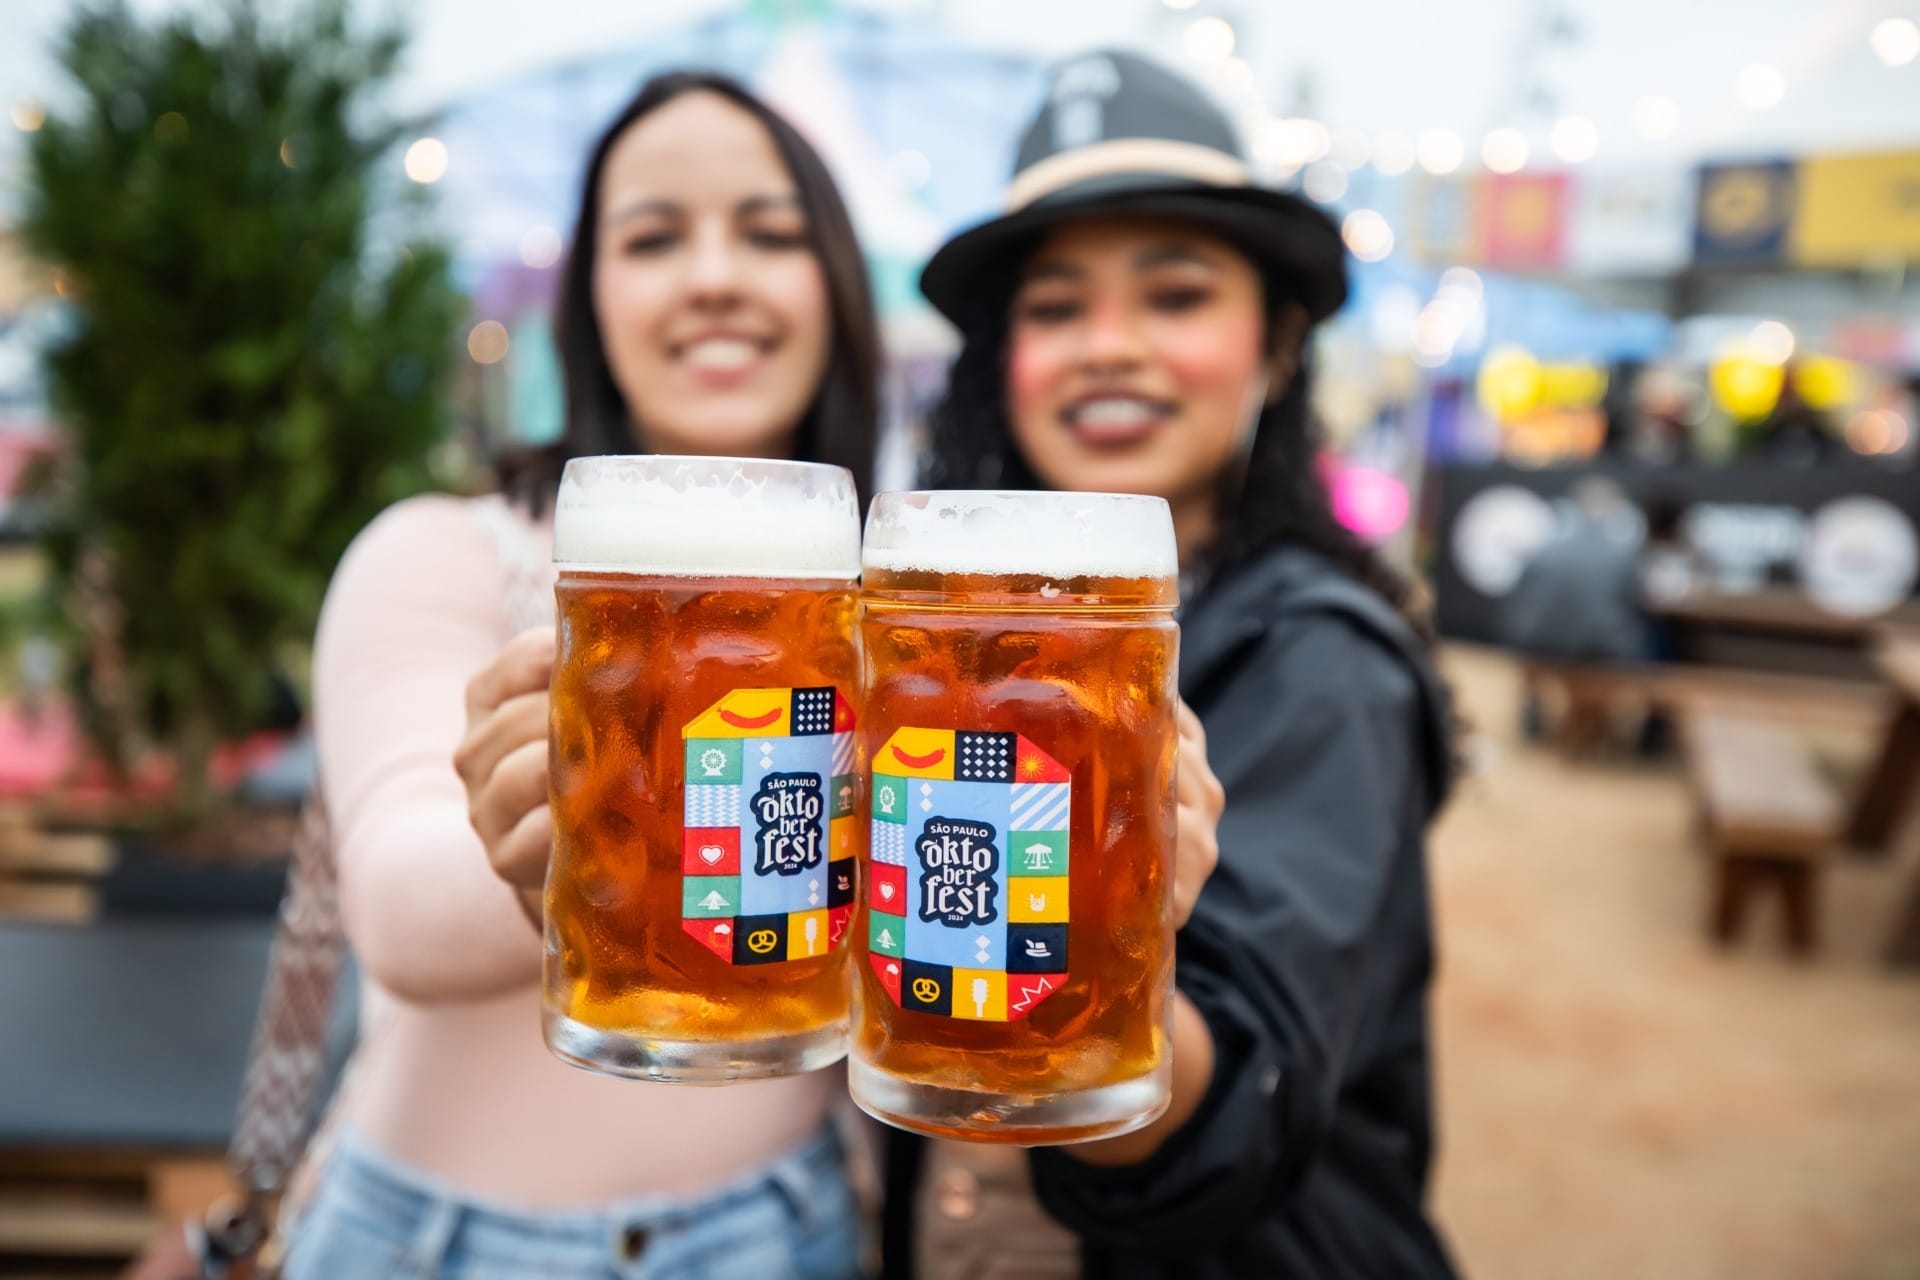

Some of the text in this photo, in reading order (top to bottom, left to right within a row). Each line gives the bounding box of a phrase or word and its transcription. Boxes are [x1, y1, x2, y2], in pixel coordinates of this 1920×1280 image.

[767, 779, 817, 790] SÃO PAULO
[780, 816, 808, 836] ber
[930, 823, 989, 838] SÃO PAULO
[762, 827, 818, 869] fest
[943, 864, 977, 886] ber
[925, 874, 990, 919] fest
